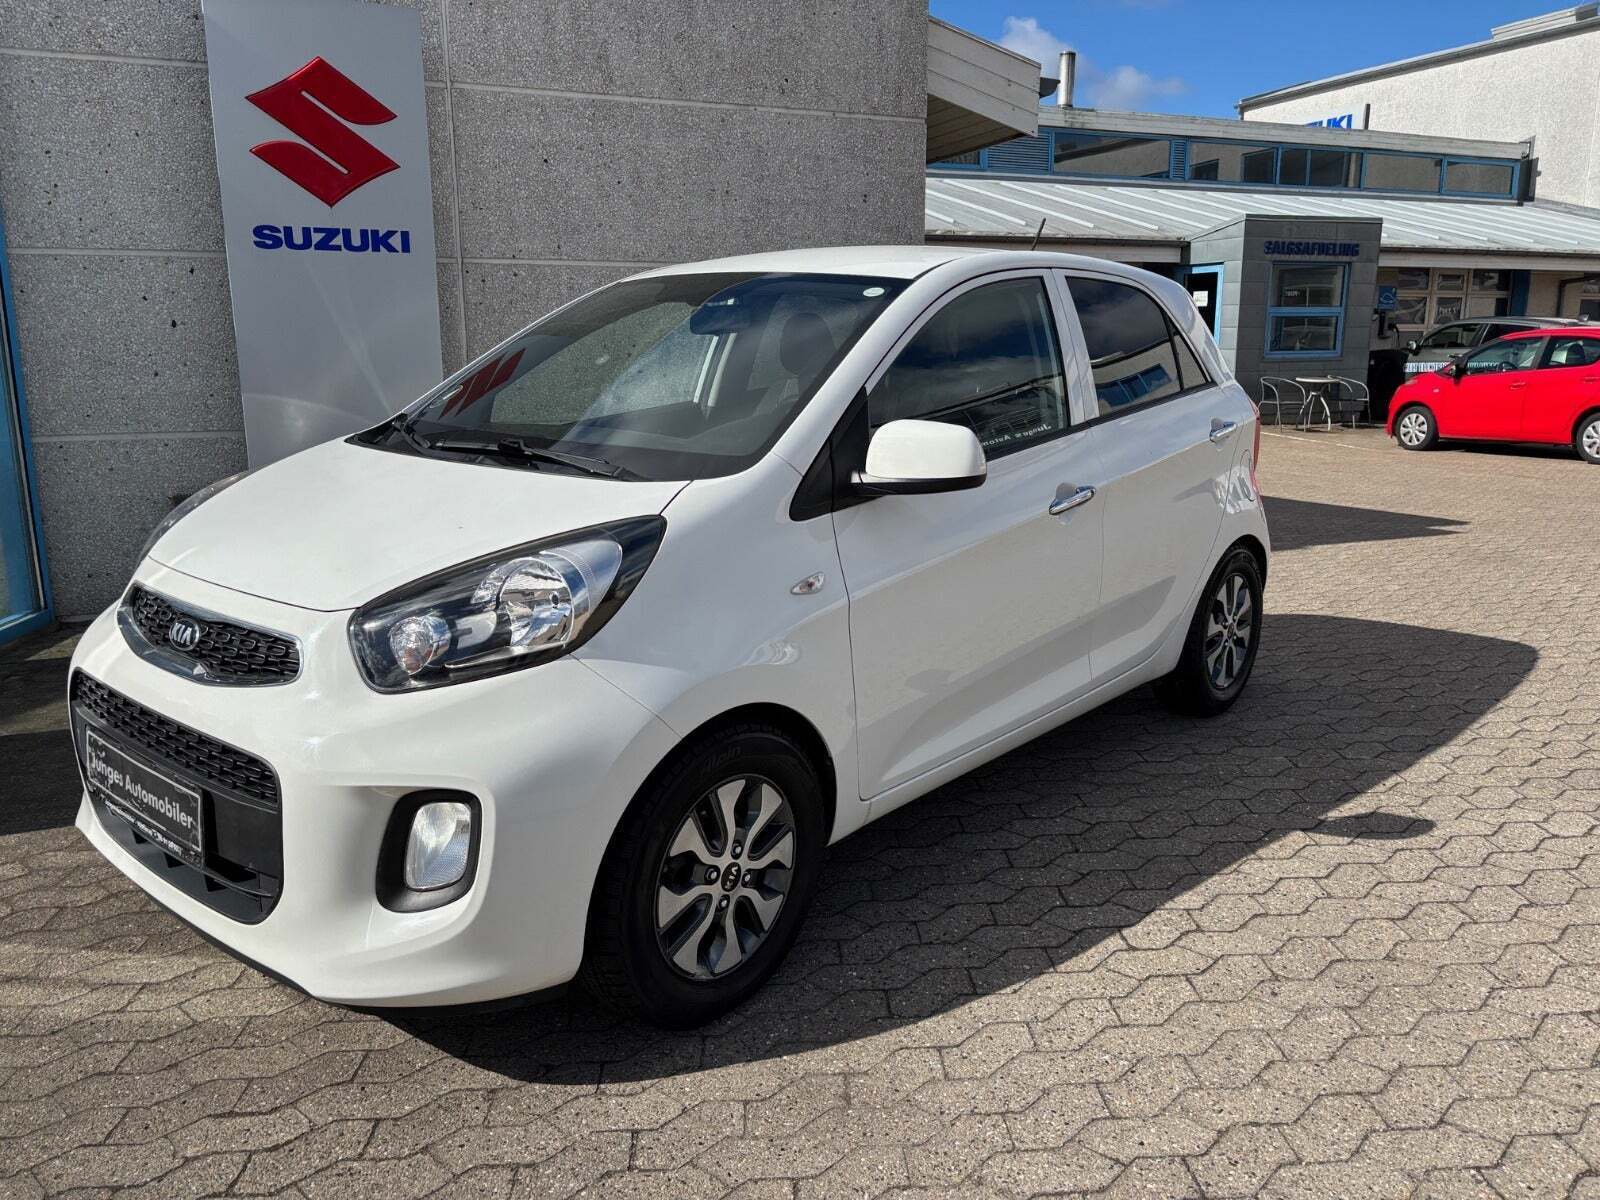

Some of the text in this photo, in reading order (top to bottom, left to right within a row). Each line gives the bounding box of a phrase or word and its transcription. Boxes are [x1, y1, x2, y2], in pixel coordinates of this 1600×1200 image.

[253, 224, 411, 253] SUZUKI
[171, 622, 192, 645] KIA
[91, 750, 123, 787] Junges
[125, 774, 194, 829] Automobiler
